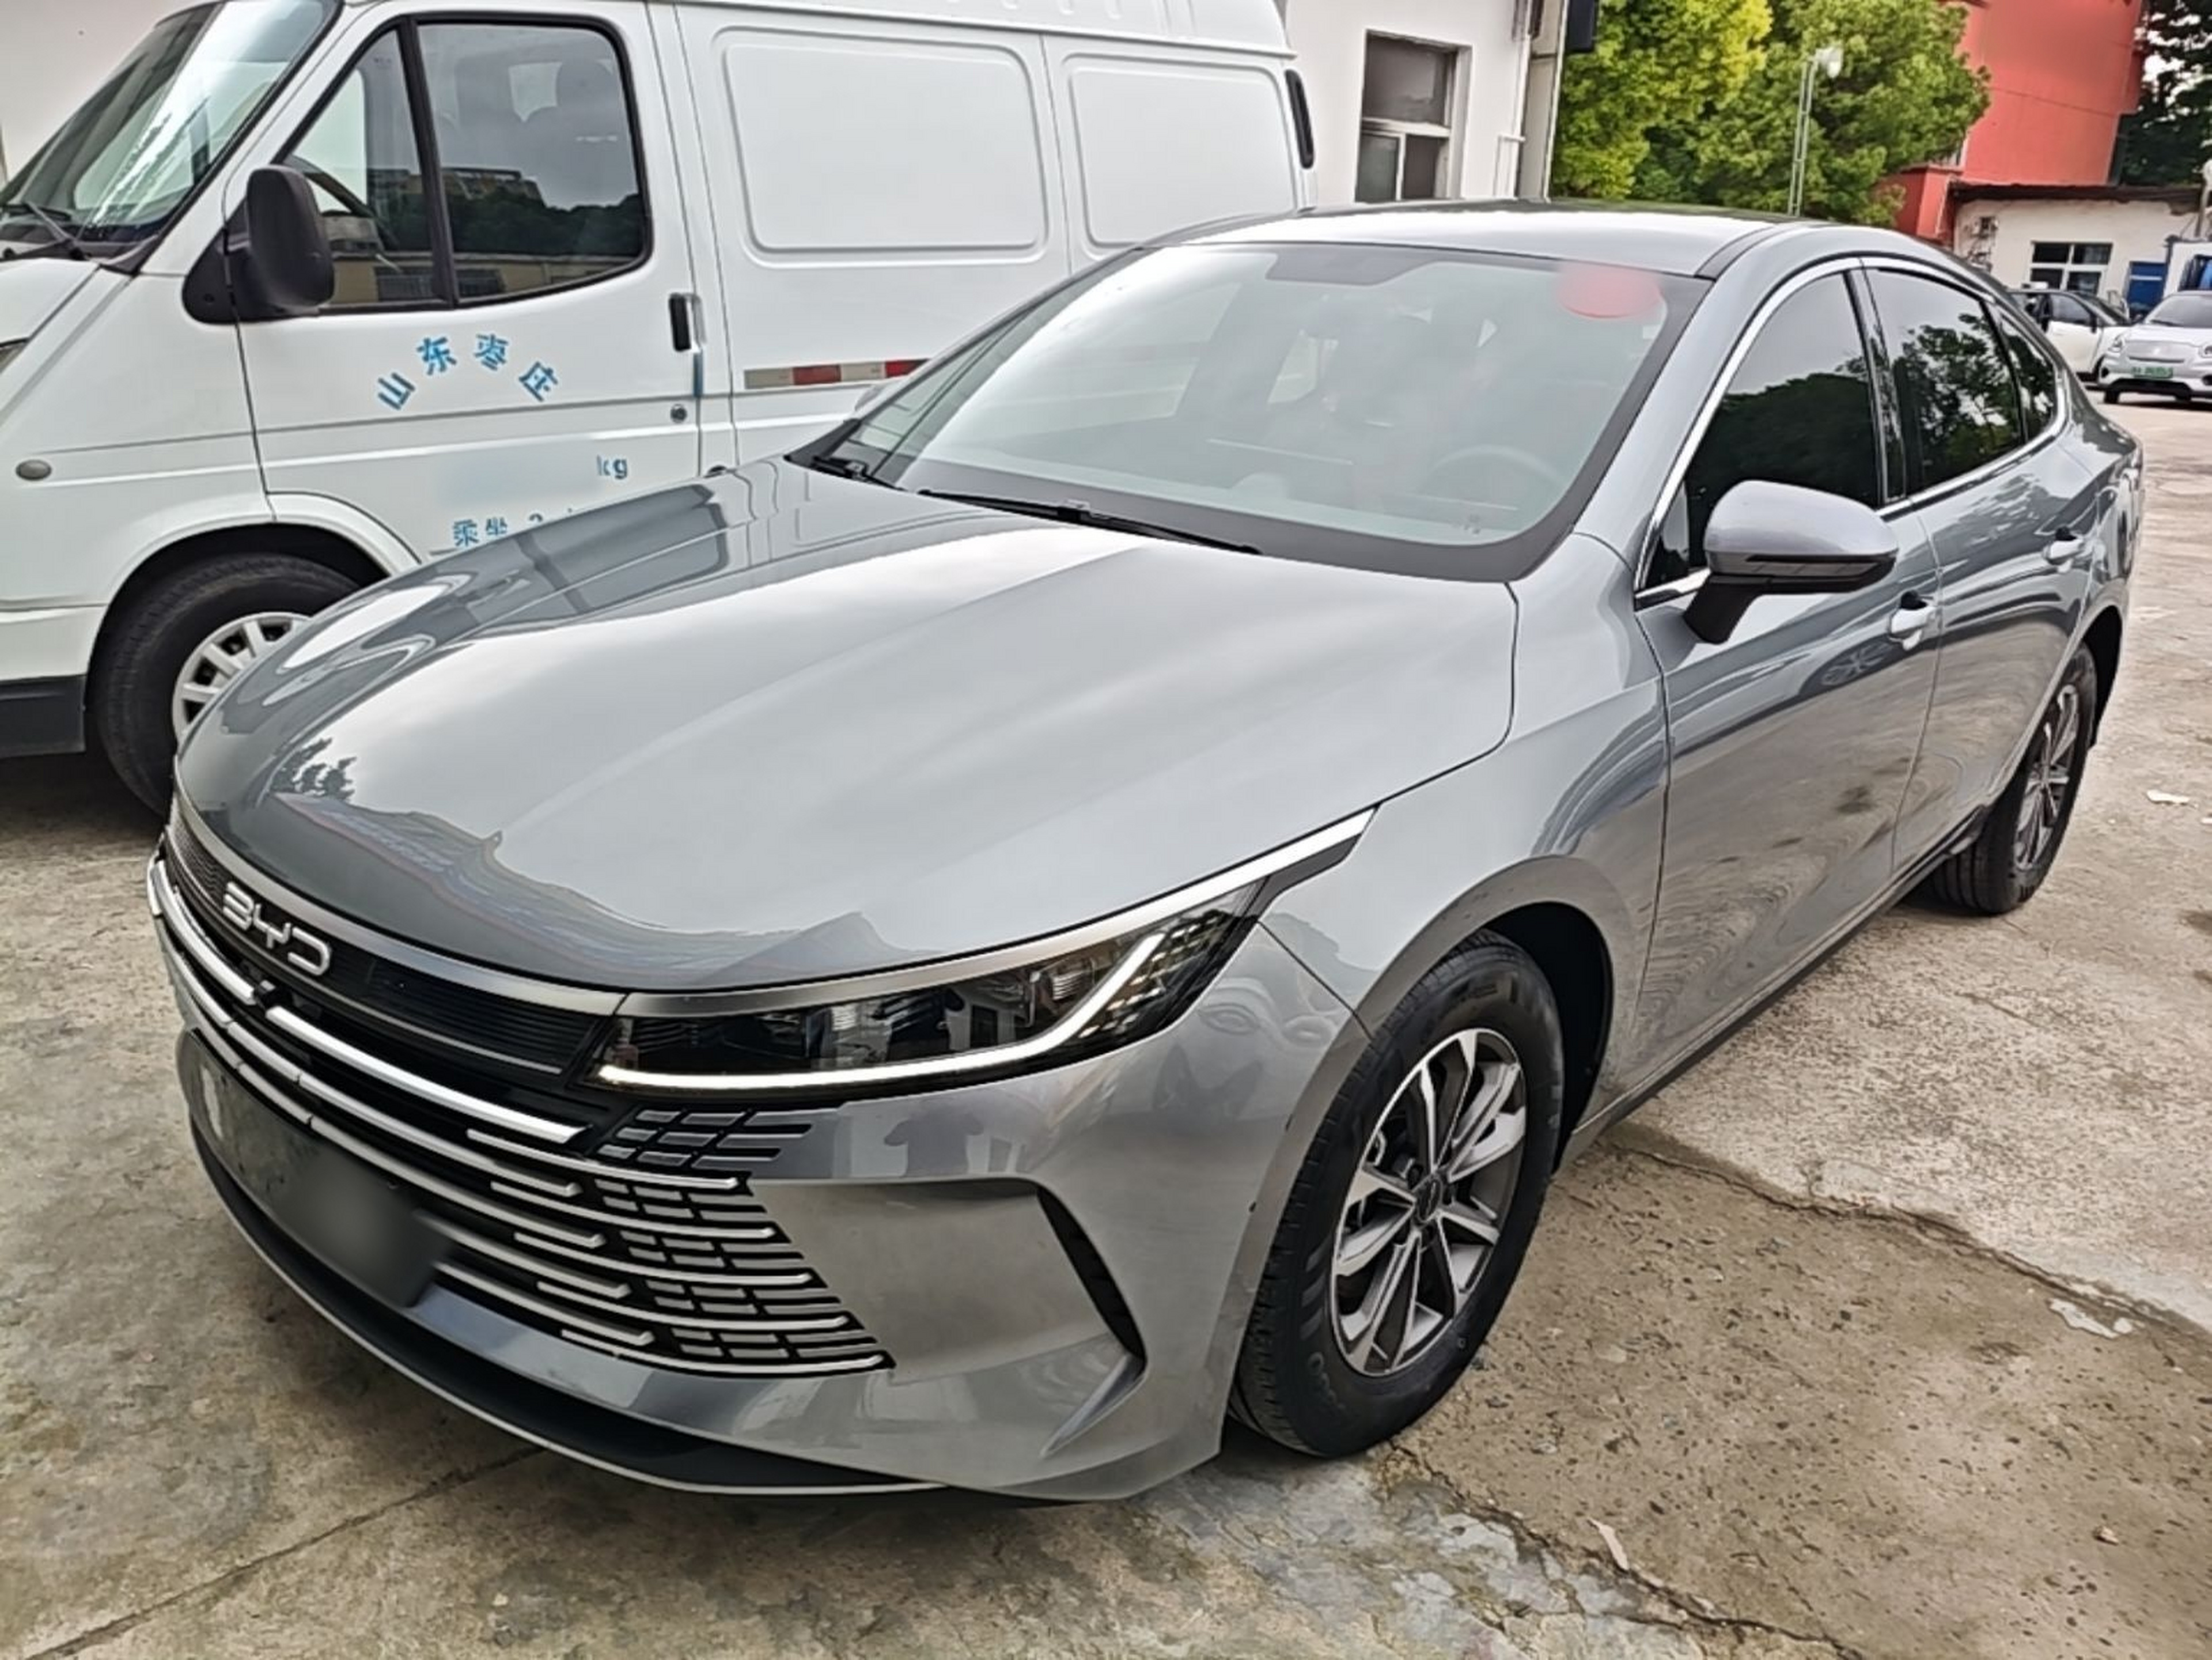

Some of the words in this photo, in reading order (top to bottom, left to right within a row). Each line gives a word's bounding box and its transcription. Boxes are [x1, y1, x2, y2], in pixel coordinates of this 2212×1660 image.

[377, 333, 559, 411] 山东枣庄
[596, 453, 627, 479] kg
[222, 881, 331, 975] BYD
